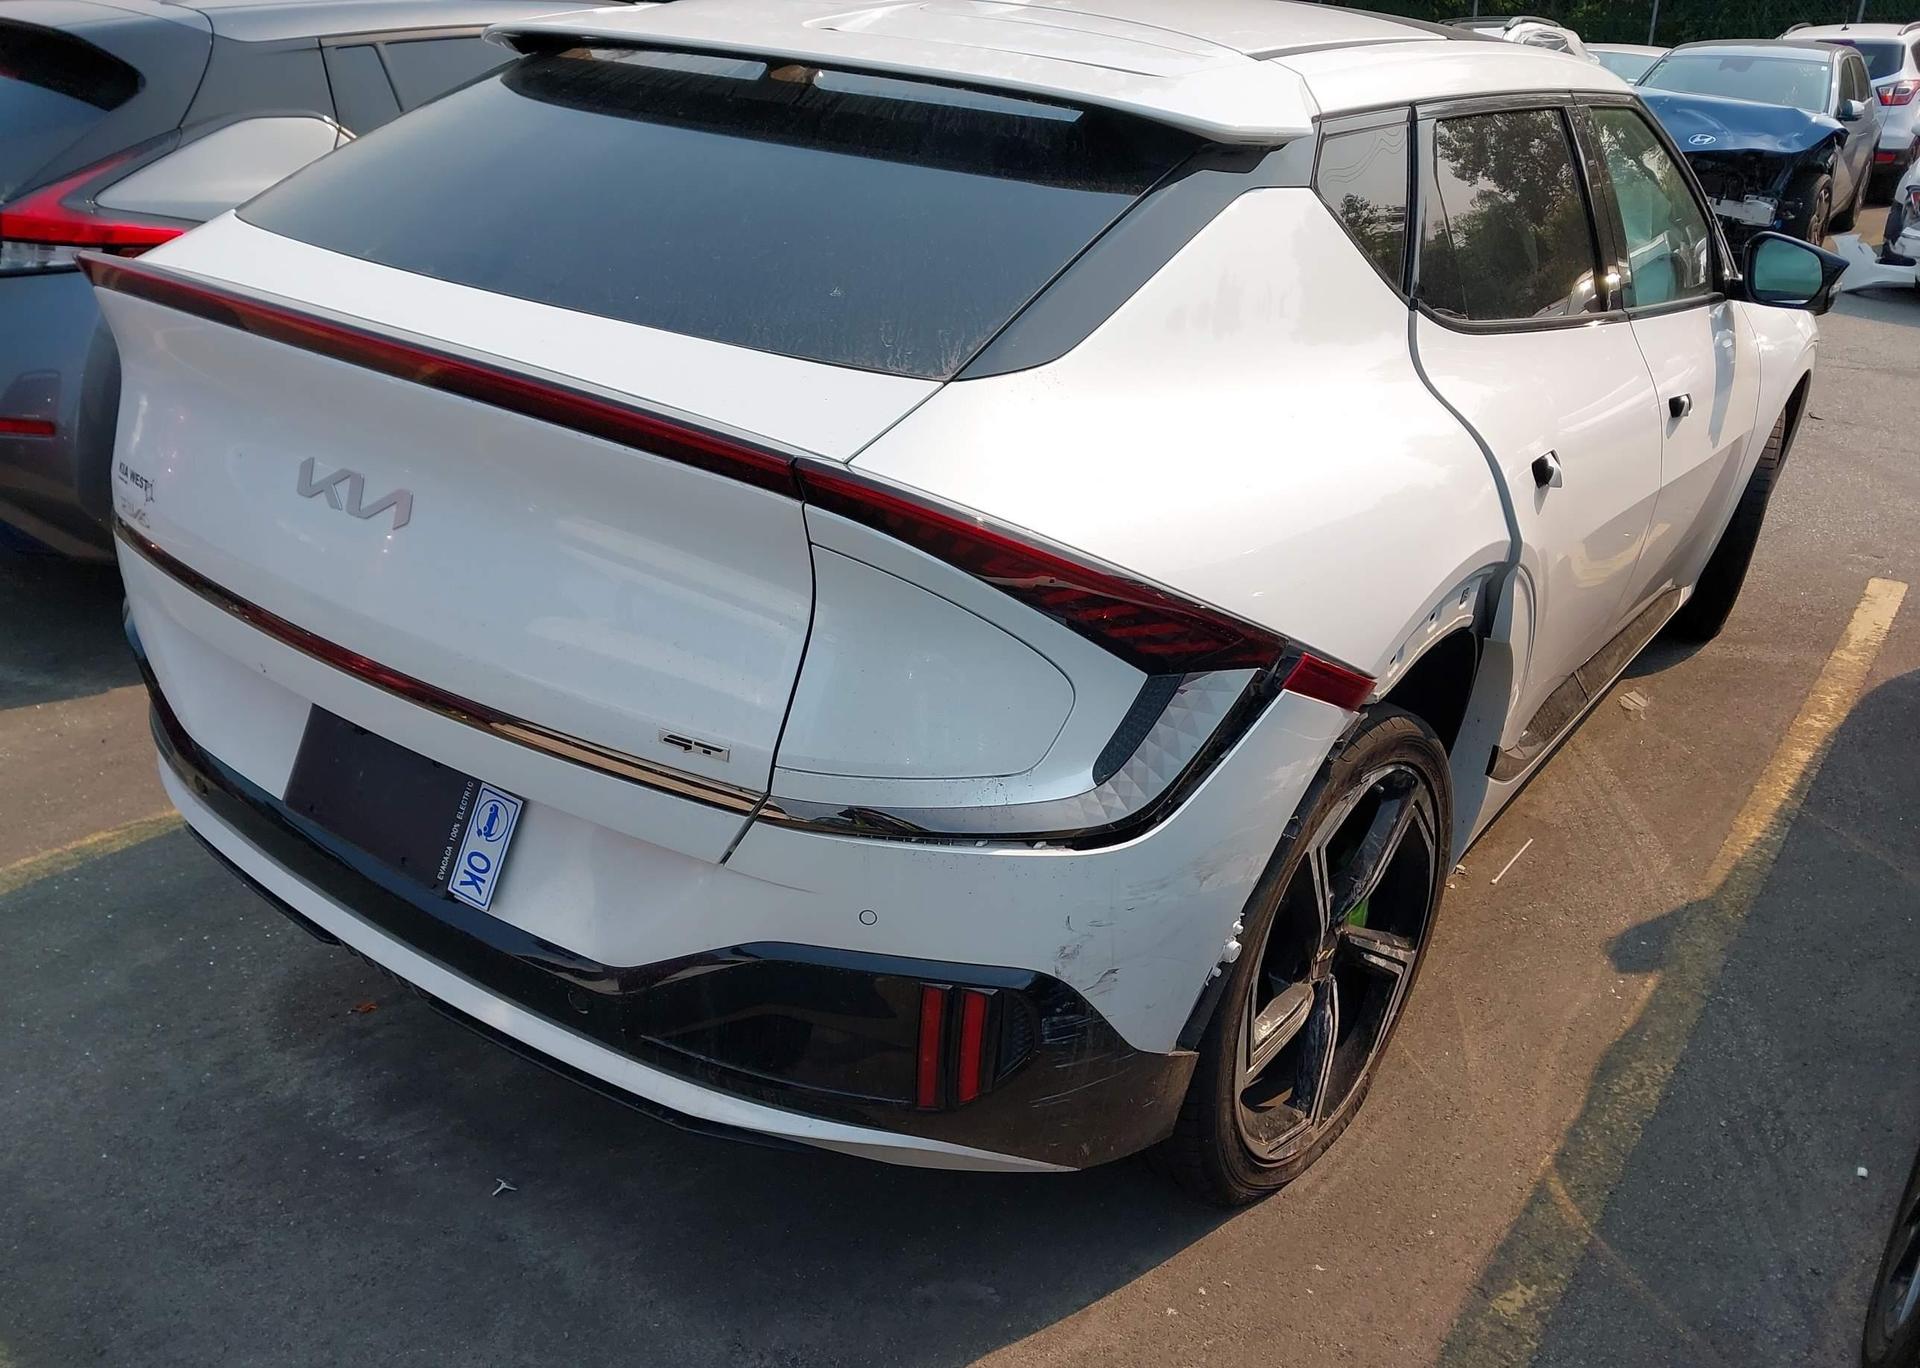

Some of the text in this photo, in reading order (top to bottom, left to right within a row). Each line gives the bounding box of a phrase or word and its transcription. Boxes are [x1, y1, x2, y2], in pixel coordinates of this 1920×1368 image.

[130, 470, 149, 491] WEST
[449, 823, 460, 842] 100%
[456, 780, 474, 820] ELECTRIC
[459, 851, 491, 896] OK
